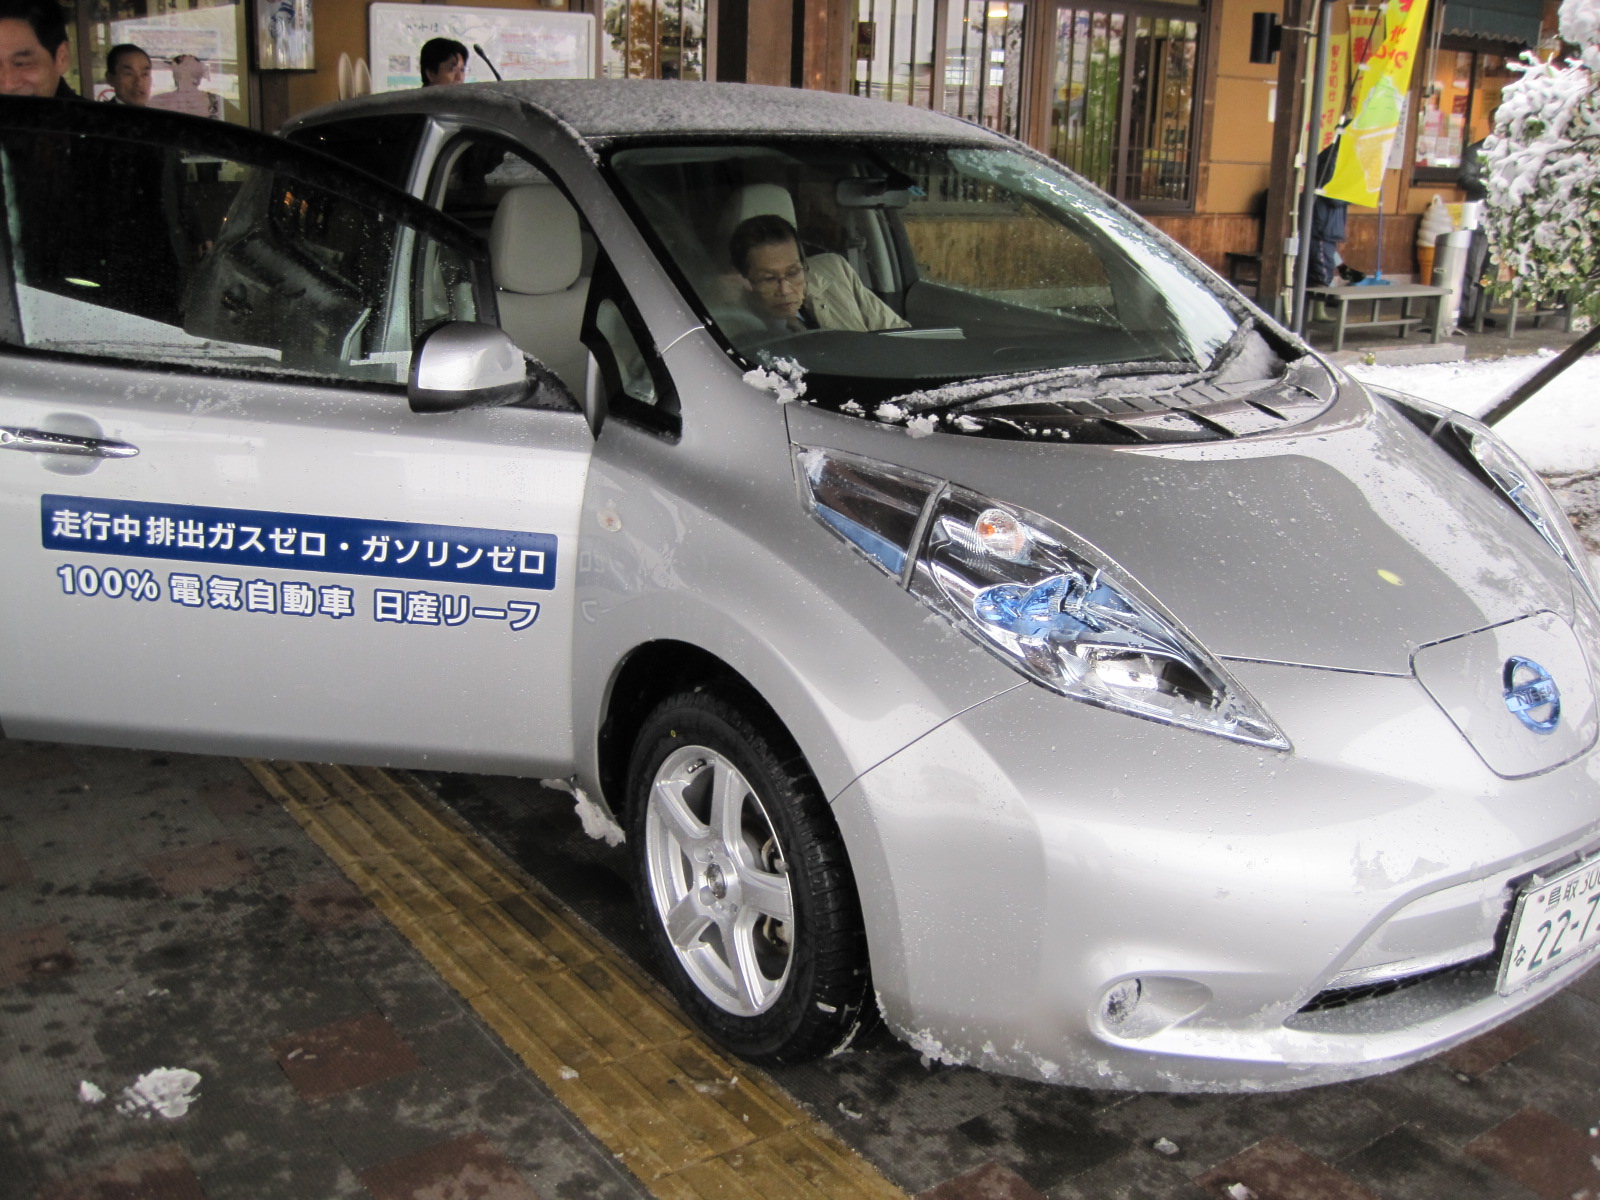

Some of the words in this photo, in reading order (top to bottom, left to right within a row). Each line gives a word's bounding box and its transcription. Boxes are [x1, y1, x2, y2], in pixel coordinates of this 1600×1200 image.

[58, 565, 160, 600] 100%
[169, 573, 353, 618] 電気自動車
[374, 588, 540, 631] 日産リーフ
[1527, 891, 1600, 971] 22-7
